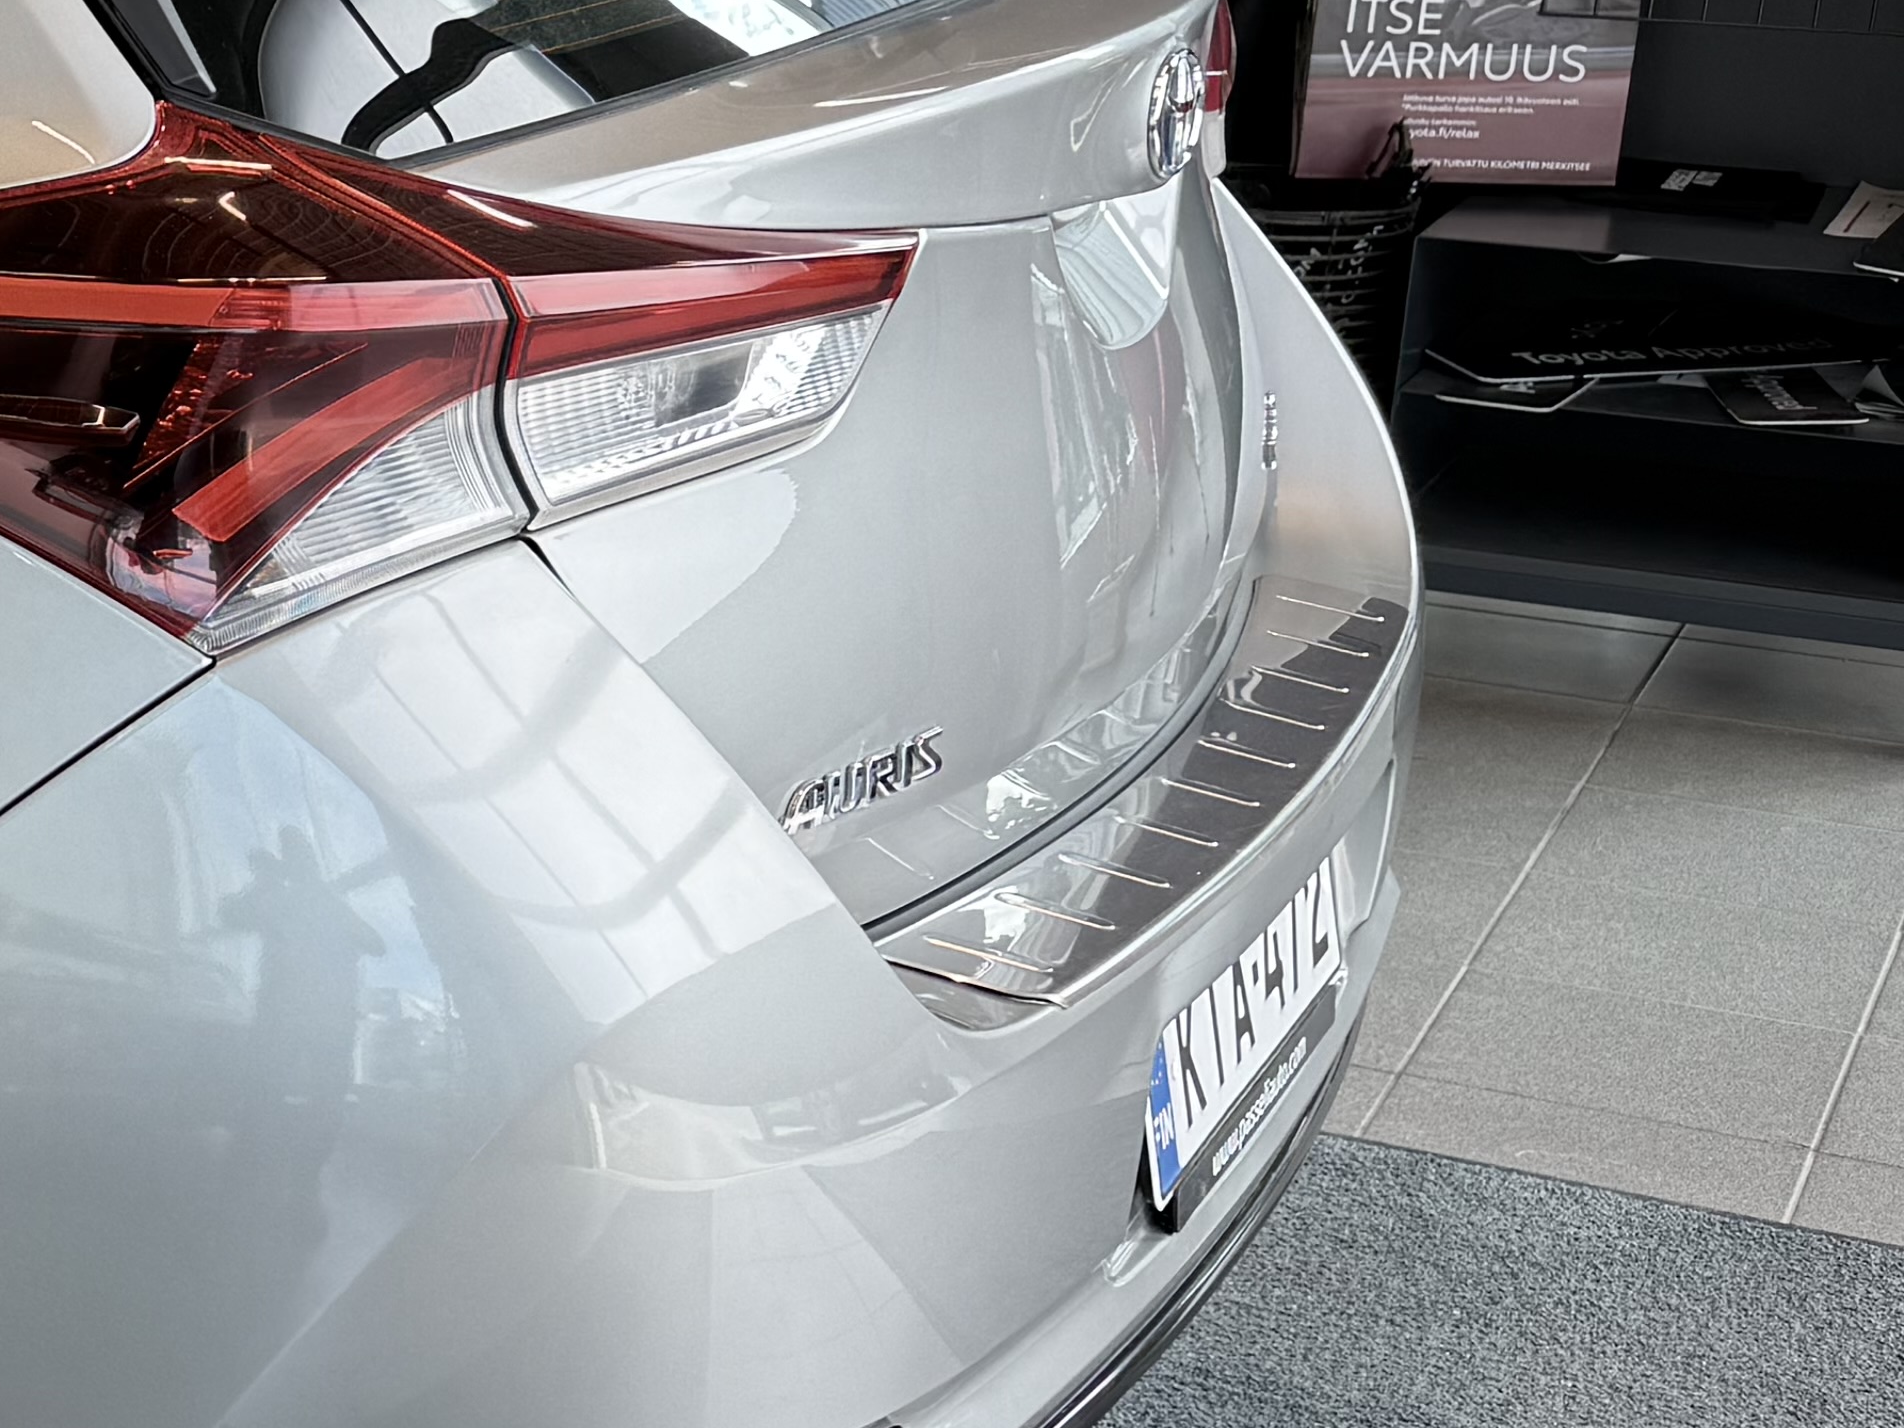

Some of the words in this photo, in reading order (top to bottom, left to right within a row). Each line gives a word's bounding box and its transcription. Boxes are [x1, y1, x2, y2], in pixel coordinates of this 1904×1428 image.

[1340, 38, 1588, 83] VARMUUS
[1511, 349, 1647, 367] Toyota
[1649, 337, 1837, 361] Approved
[777, 725, 944, 835] AURIS
